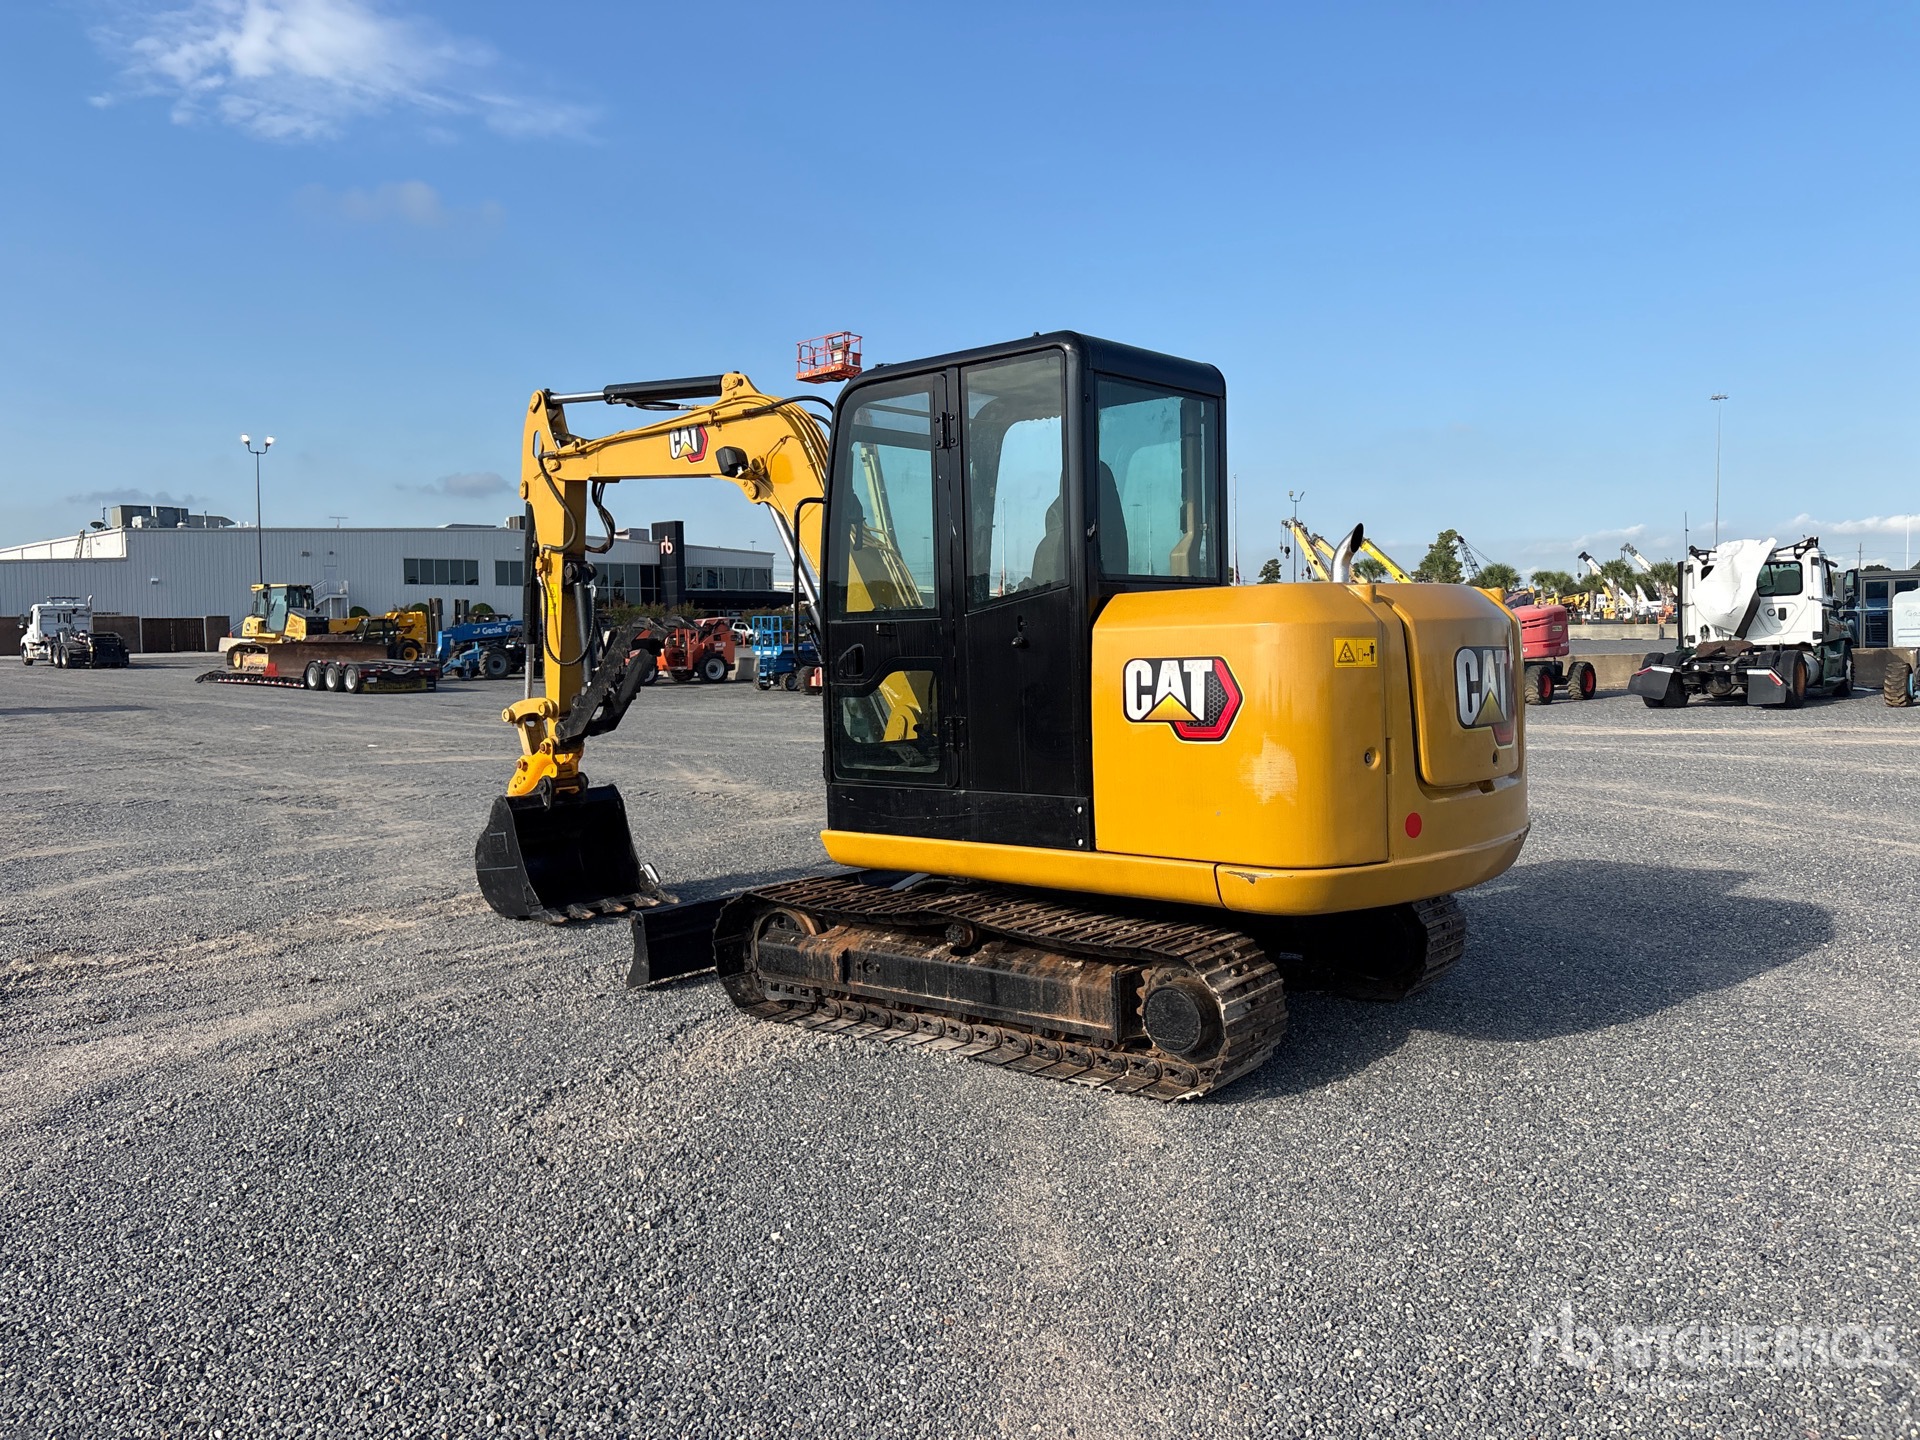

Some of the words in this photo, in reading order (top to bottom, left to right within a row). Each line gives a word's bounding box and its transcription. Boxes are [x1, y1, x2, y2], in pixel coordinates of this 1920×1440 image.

[669, 424, 698, 459] CAT
[660, 535, 673, 554] rb
[1125, 659, 1213, 721] CAT
[1456, 648, 1507, 726] CAT
